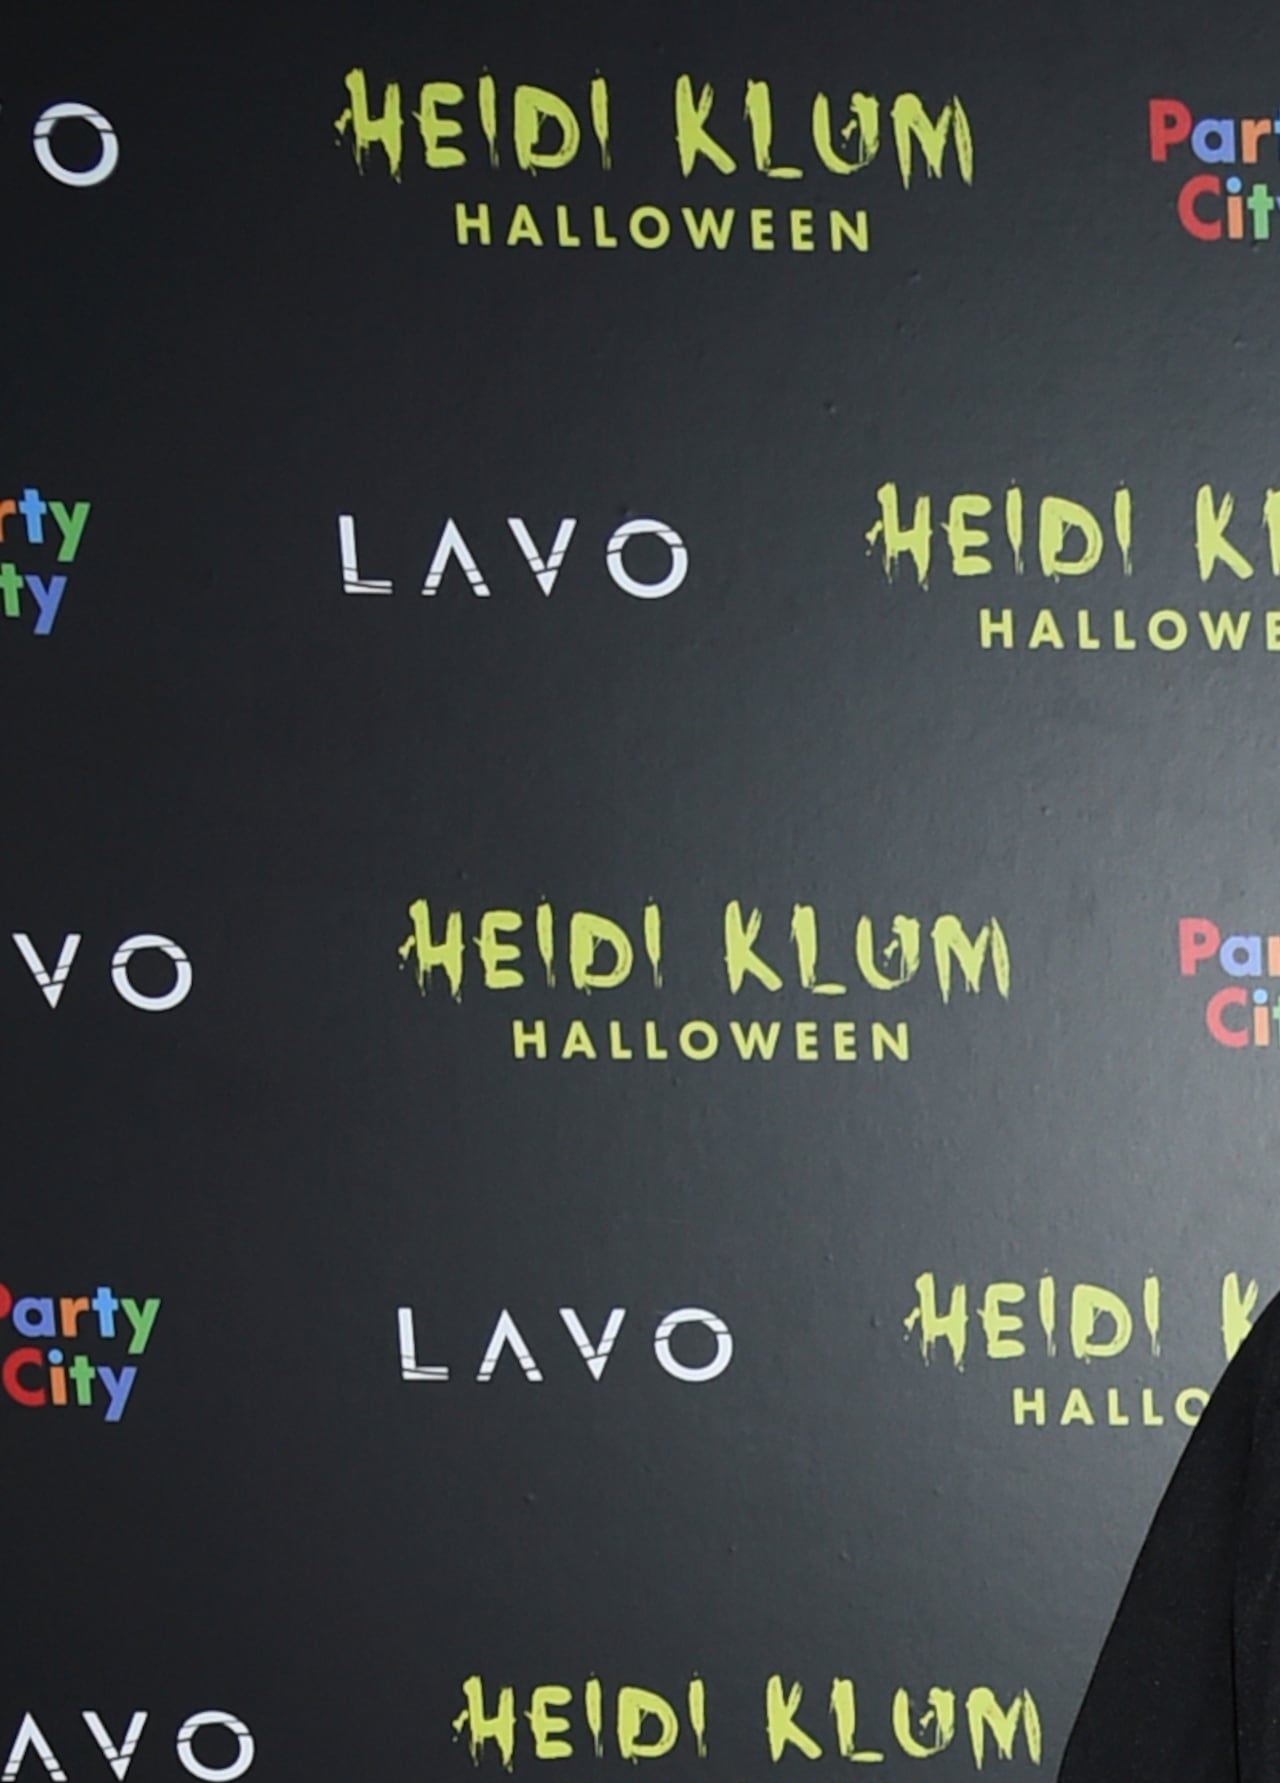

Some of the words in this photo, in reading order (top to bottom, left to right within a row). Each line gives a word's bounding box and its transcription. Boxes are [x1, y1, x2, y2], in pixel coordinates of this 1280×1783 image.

[334, 68, 610, 182] HEIDI
[676, 75, 973, 189] KLUM
[456, 203, 868, 251] HALLOWEEN
[339, 515, 688, 598] LAVO
[866, 482, 1131, 590] HEIDI
[399, 896, 662, 1003] HEIDI
[725, 900, 1009, 1003] KLUM
[513, 1020, 908, 1060] HALLOWEEN
[398, 1307, 732, 1381] LAVO
[904, 1273, 1160, 1371] HEIDI
[2, 1347, 137, 1421] City
[453, 1676, 706, 1772] HEIDI
[766, 1675, 1041, 1770] KLUM
